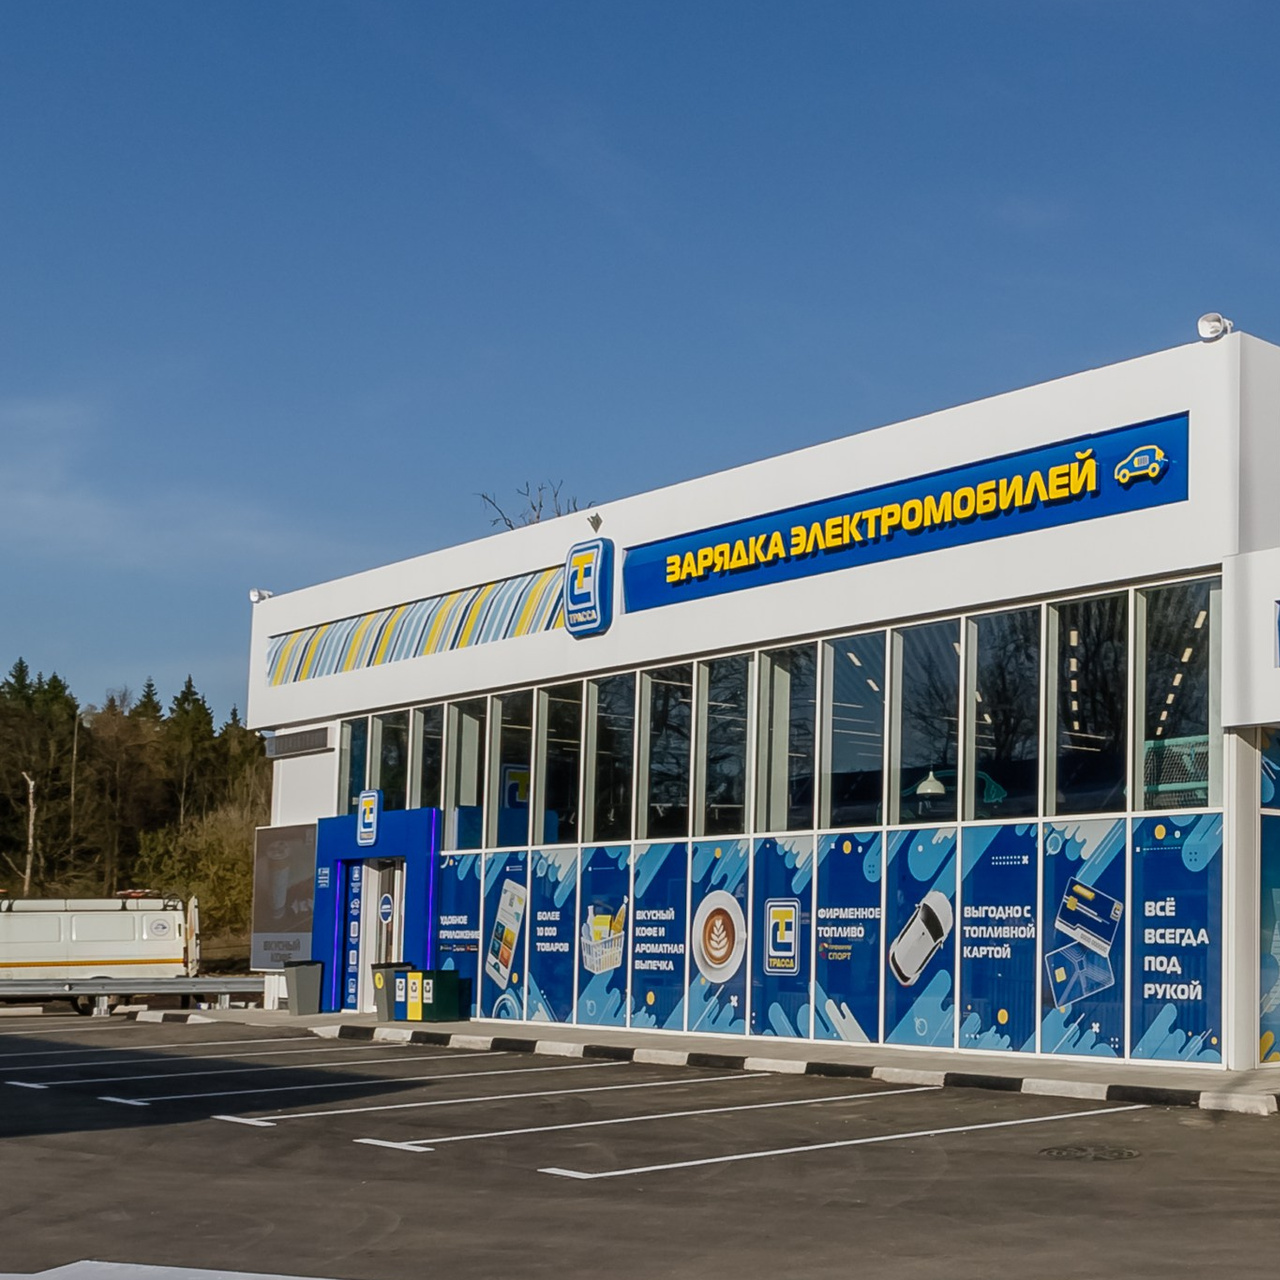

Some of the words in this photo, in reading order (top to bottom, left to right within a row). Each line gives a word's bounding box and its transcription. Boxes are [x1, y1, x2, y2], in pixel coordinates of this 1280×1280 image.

[666, 529, 785, 584] ЗАРЯДКА
[790, 449, 1097, 557] ЭЛЕКТРОМОБИЛЕЙ
[963, 906, 1023, 919] ВЫГОДНО
[1023, 906, 1031, 918] С
[1144, 897, 1176, 917] ВСЁ
[536, 911, 560, 921] БОЛЕЕ
[635, 908, 675, 920] ВКУСНЫЙ
[817, 908, 881, 919] ФИРМЕННОЕ
[536, 927, 544, 936] 10
[635, 927, 658, 937] КОФЕ
[658, 927, 665, 937] И
[817, 926, 865, 938] ТОПЛИВО
[963, 923, 1035, 939] ТОПЛИВНОЙ
[1144, 928, 1210, 947] ВСЕГДА
[536, 943, 570, 953] ТОВАРОВ
[634, 944, 685, 954] АРОМАТНАЯ
[963, 943, 1011, 959] КАРТОЙ
[828, 952, 852, 961] СПОРТ
[634, 960, 675, 971] ВЫПЕЧКА
[769, 958, 795, 968] ТРАССА
[1144, 956, 1182, 974] ПОД
[1143, 980, 1202, 1000] РУКОЙ
